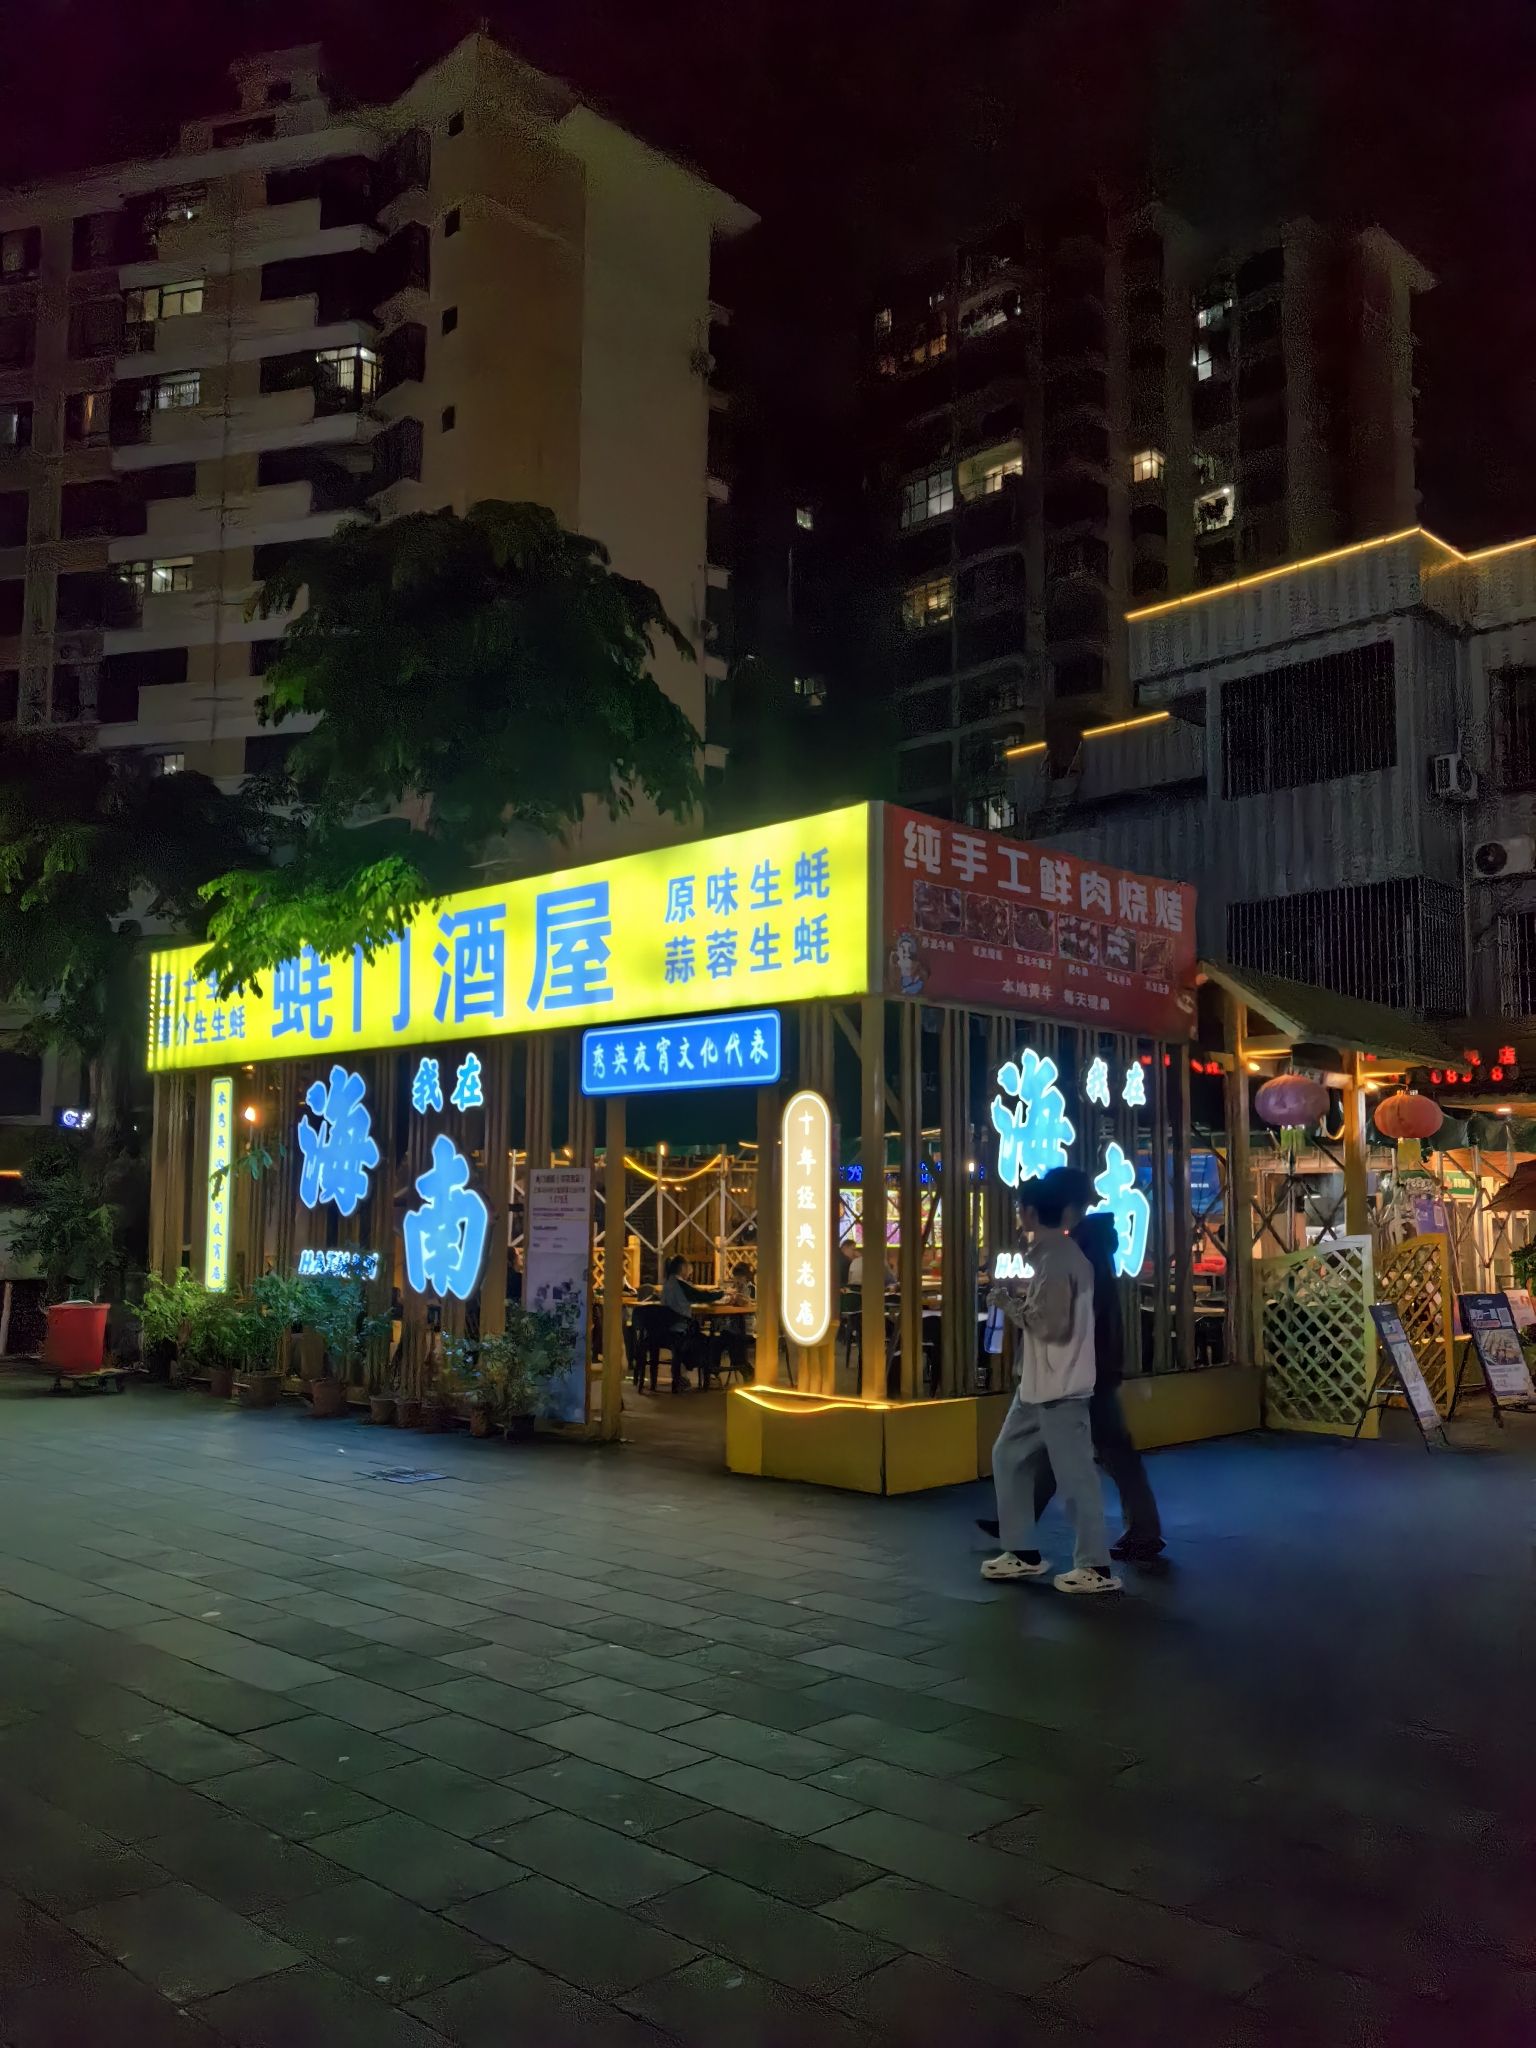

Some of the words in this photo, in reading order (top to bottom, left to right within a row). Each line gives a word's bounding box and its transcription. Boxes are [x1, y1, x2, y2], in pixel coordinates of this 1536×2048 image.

[665, 847, 830, 923] 原味生蚝
[903, 821, 1182, 931] 纯手工鲜肉烧烤
[272, 881, 613, 1039] 蚝门酒屋
[665, 913, 830, 984] 蒜蓉生蚝
[412, 1052, 484, 1114] 我在
[593, 1027, 768, 1078] 秀英夜宵文化代表
[796, 1110, 817, 1327] 十年经典老店
